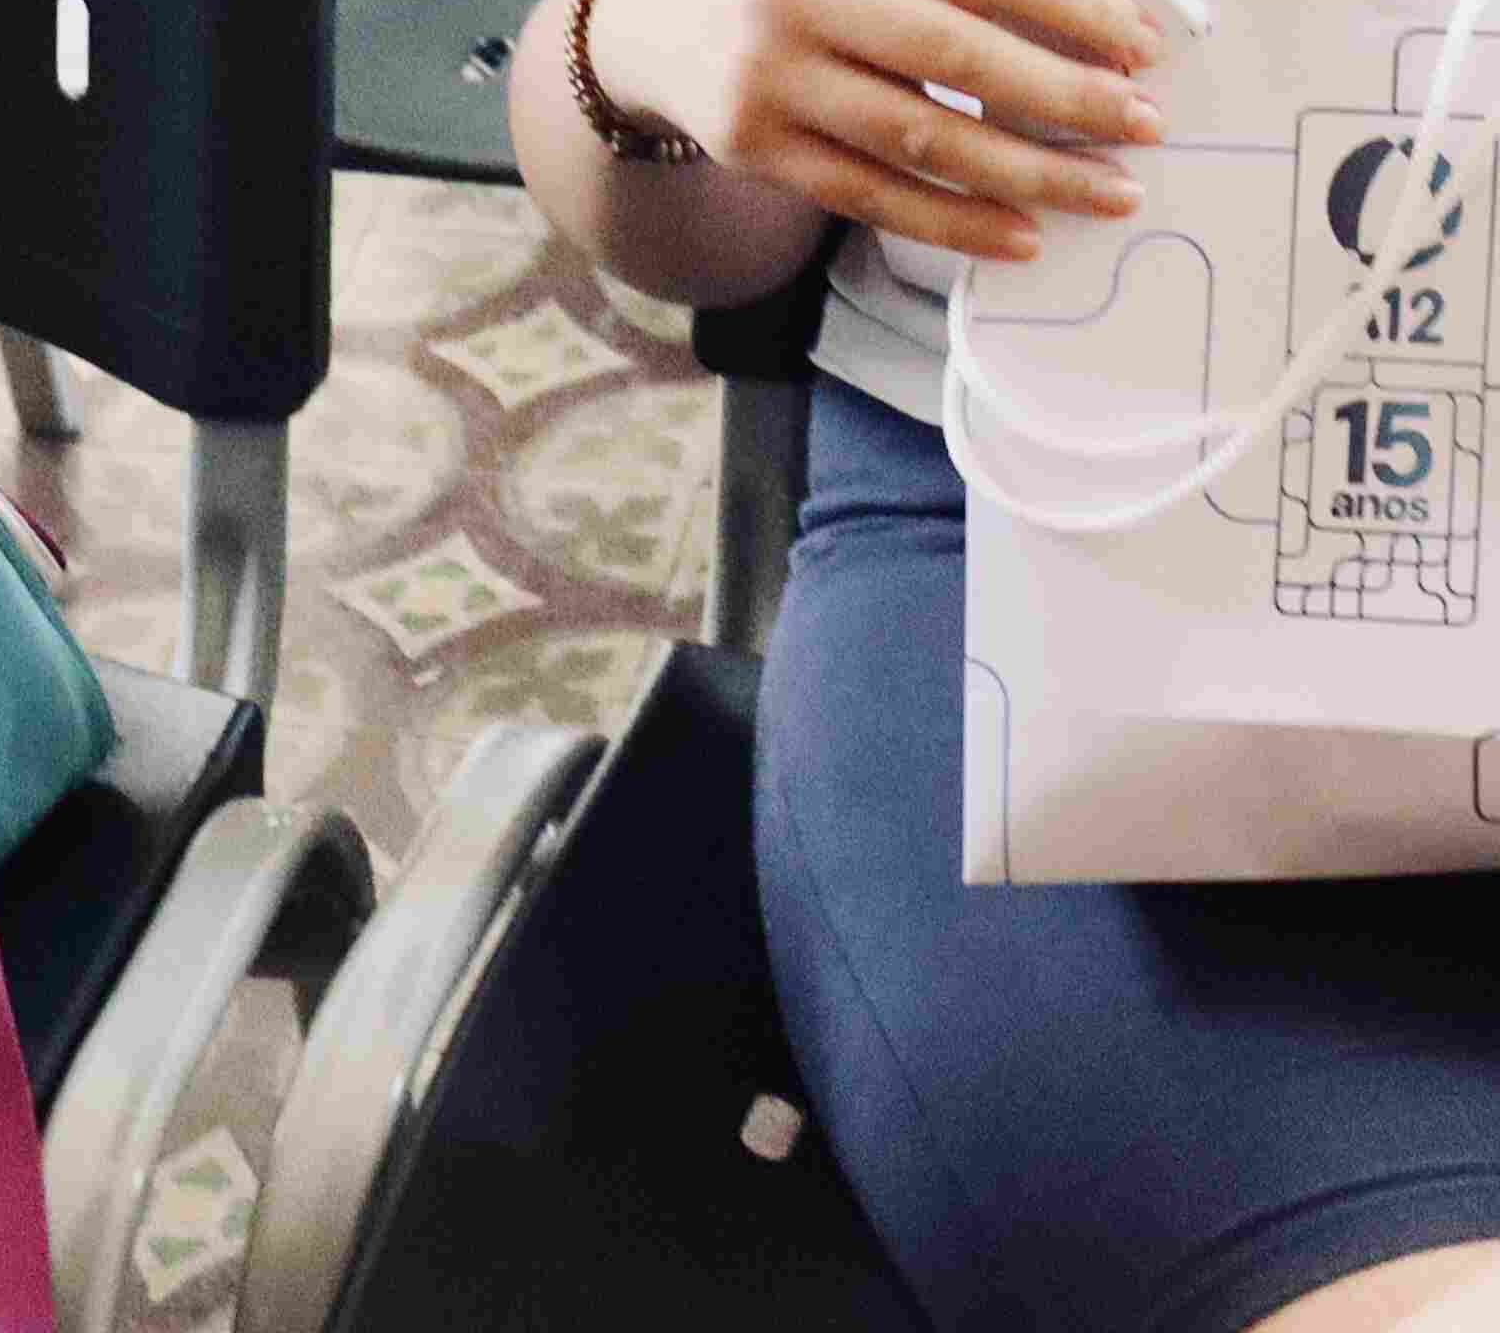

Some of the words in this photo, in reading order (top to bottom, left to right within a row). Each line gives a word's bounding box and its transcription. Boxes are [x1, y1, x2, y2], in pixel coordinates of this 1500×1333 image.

[1346, 282, 1445, 343] 12
[1335, 399, 1433, 487] 15
[1331, 491, 1430, 522] anos
